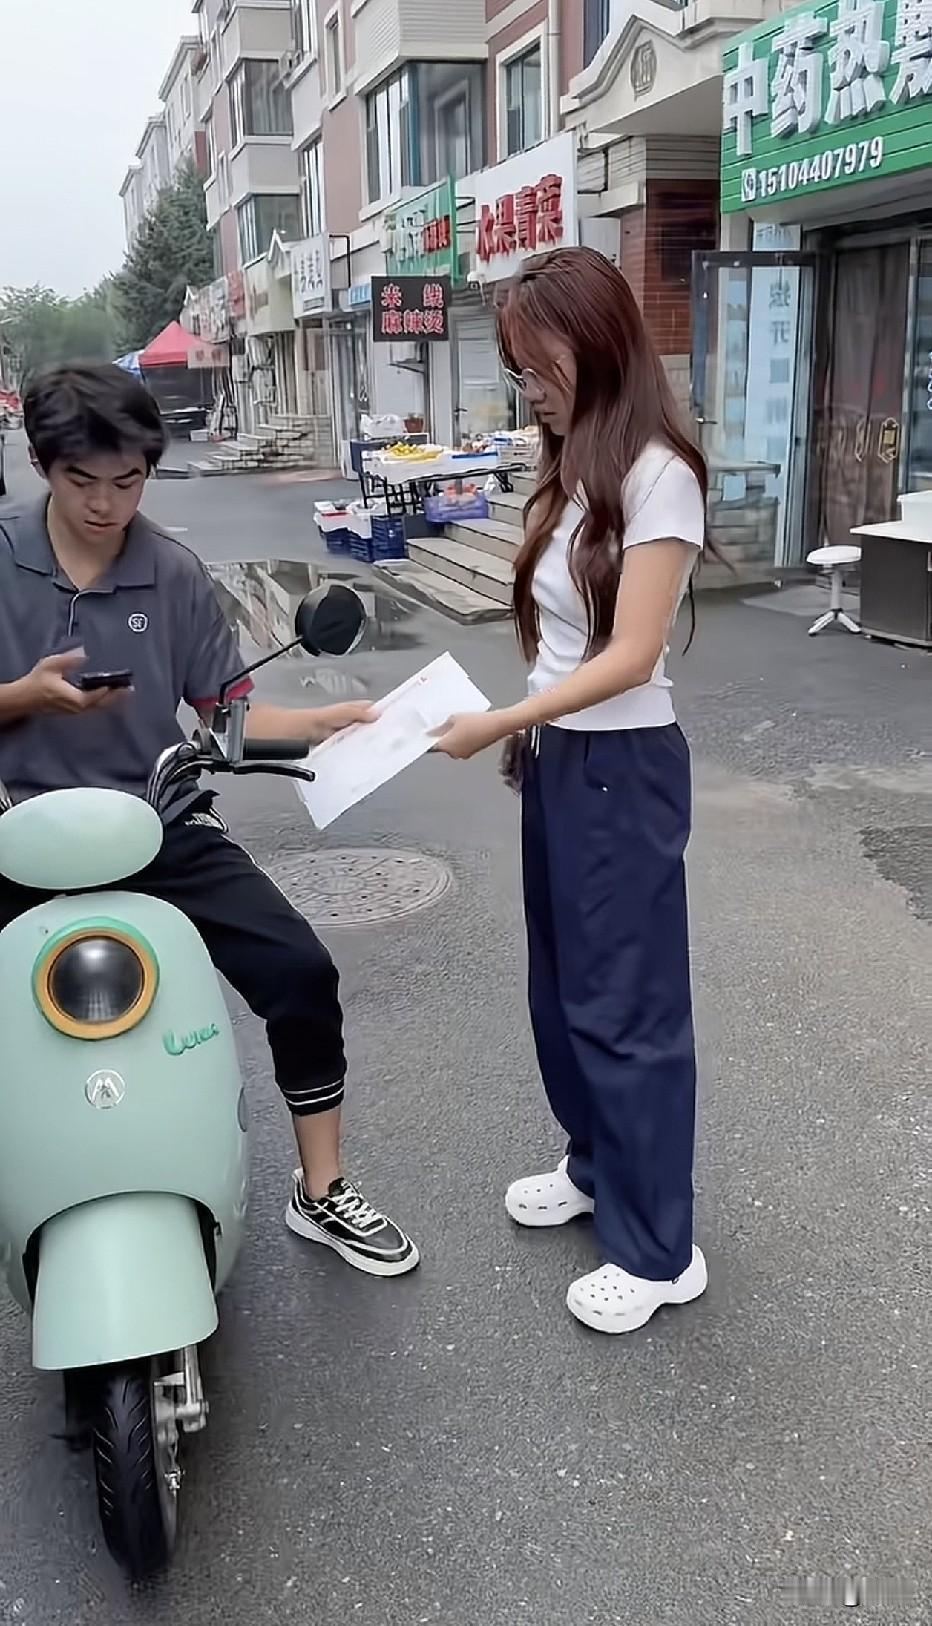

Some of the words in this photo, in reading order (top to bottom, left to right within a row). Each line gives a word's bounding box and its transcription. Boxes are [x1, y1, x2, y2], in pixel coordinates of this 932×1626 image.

[758, 136, 884, 197] 15104407979
[475, 173, 564, 264] 水果青菜
[381, 309, 445, 335] 麻辣烫
